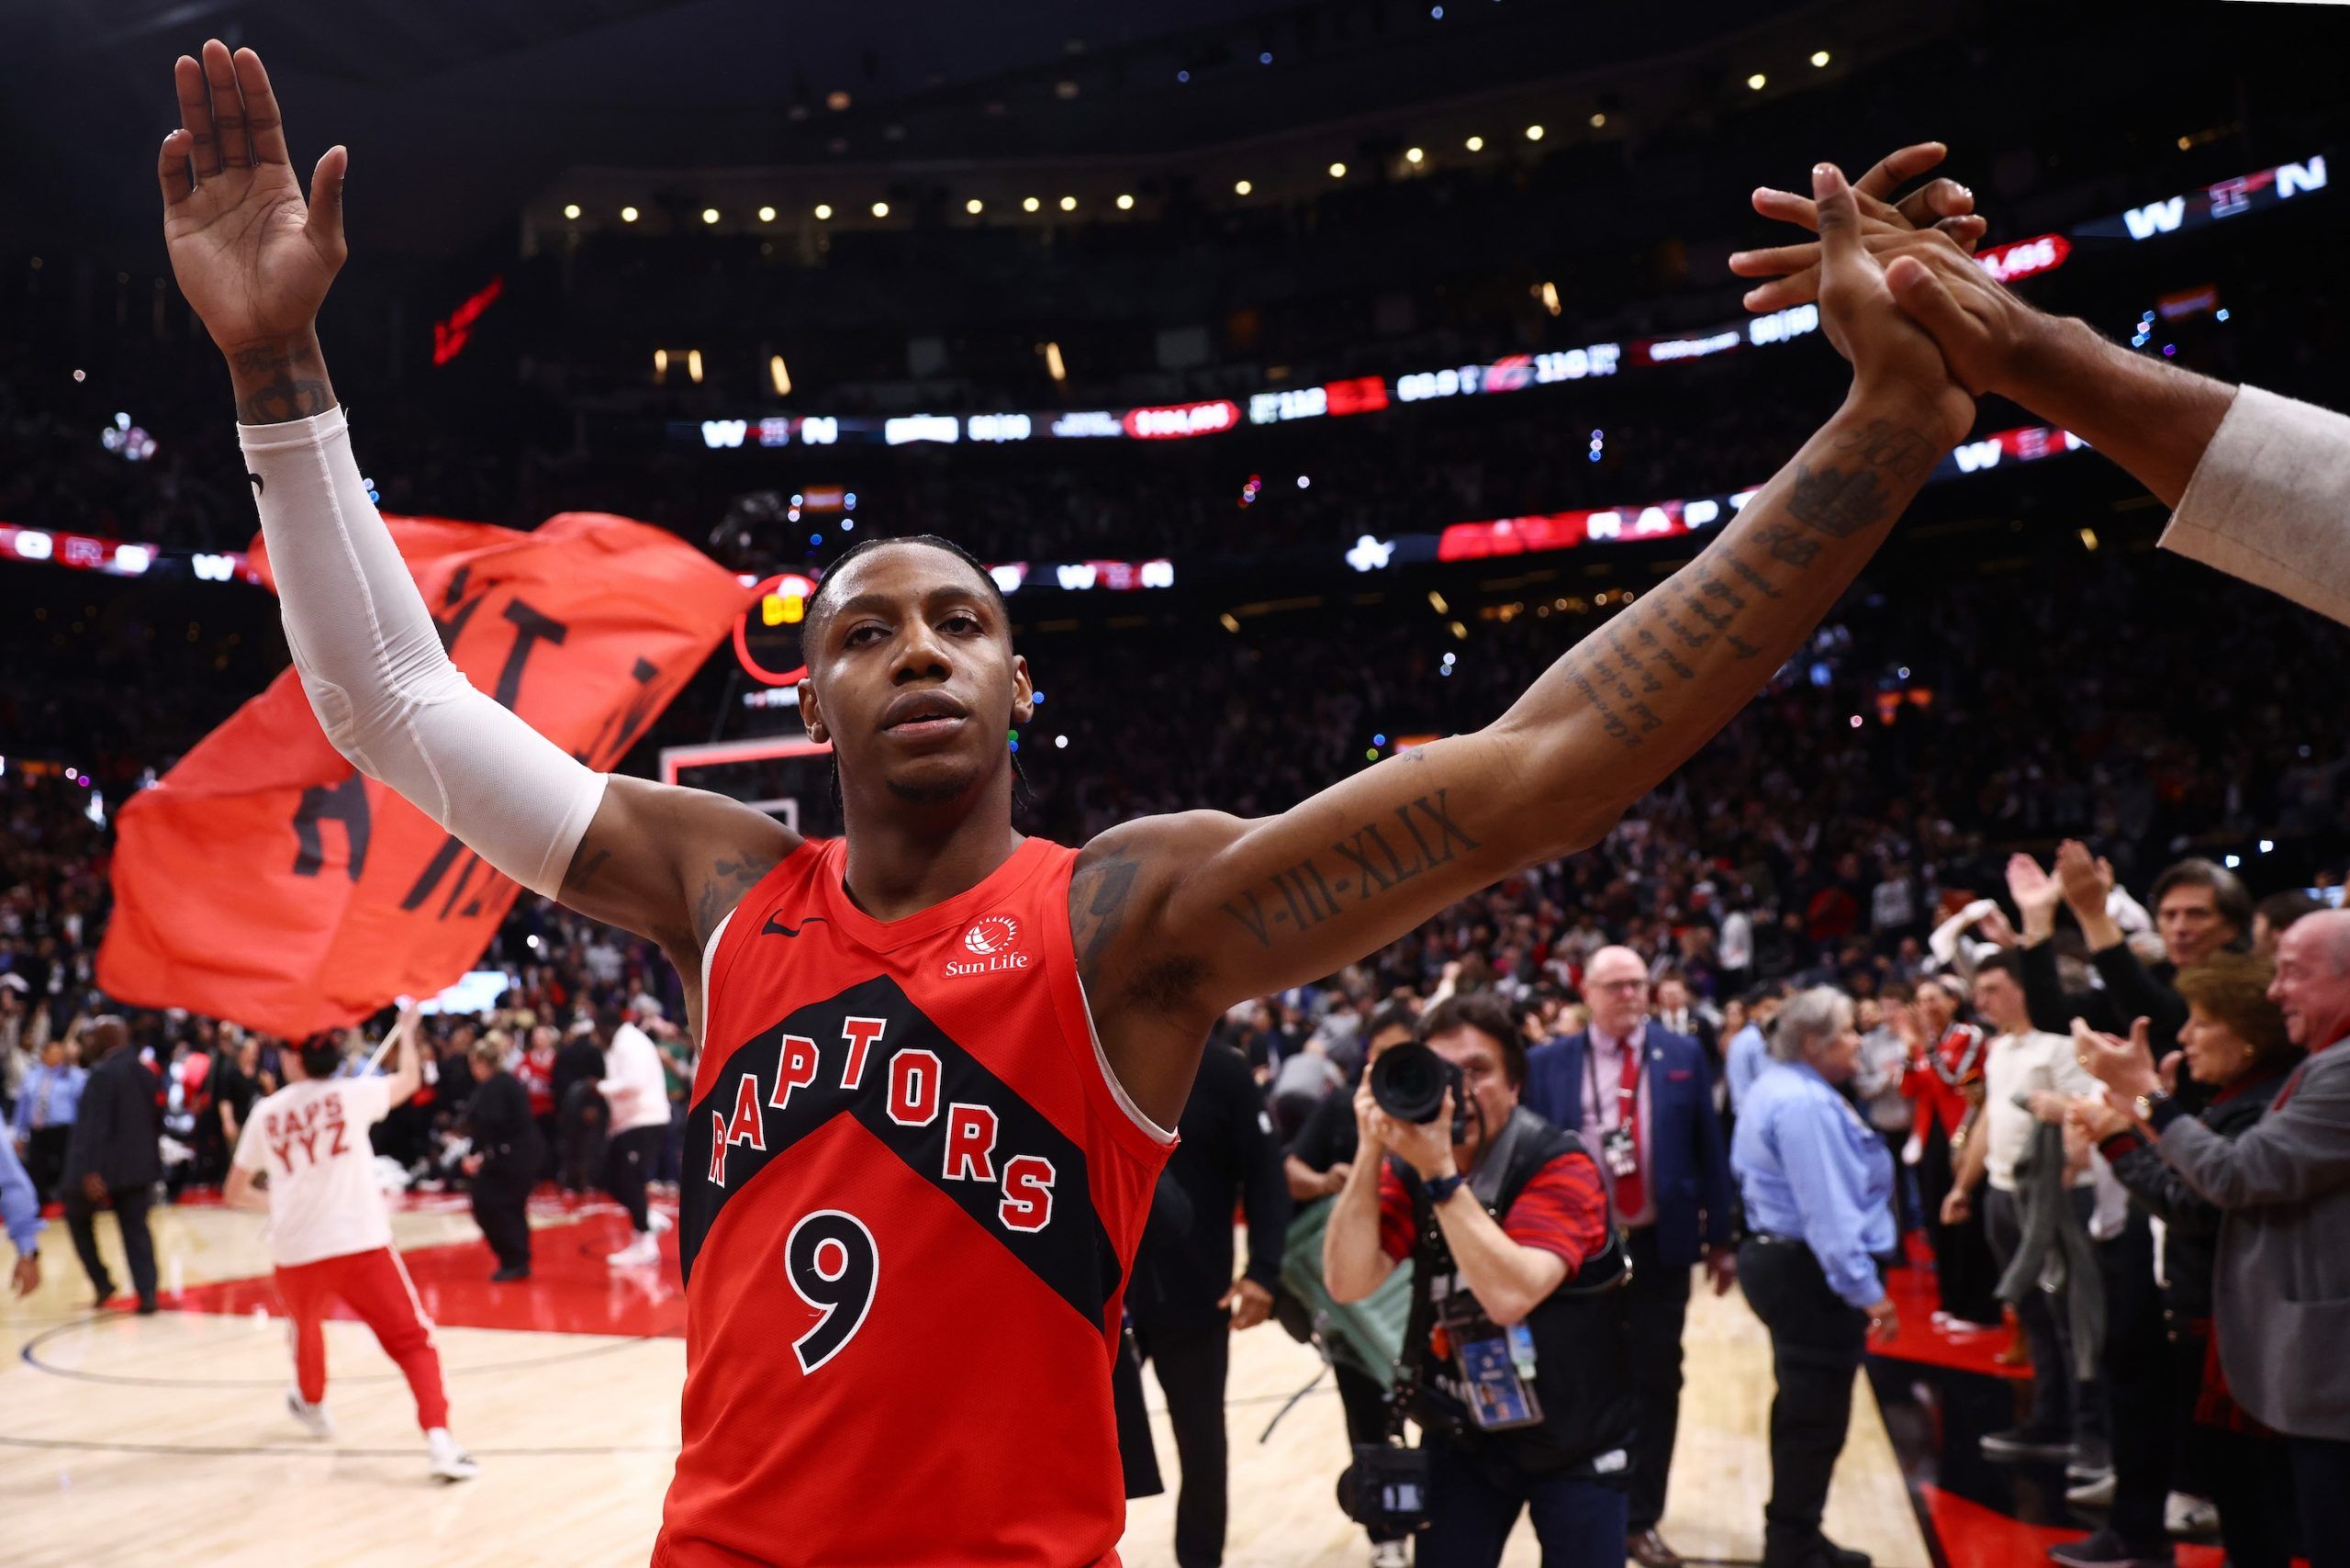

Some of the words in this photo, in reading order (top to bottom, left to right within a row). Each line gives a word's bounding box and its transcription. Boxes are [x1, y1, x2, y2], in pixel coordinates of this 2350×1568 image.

[2123, 154, 2328, 241] WIN
[945, 961, 985, 977] Sun
[990, 951, 1028, 971] Life
[266, 1092, 342, 1138] RAPS
[273, 1120, 352, 1175] YYZ
[708, 1015, 1056, 1234] RAPTORS
[784, 1208, 879, 1375] 9
